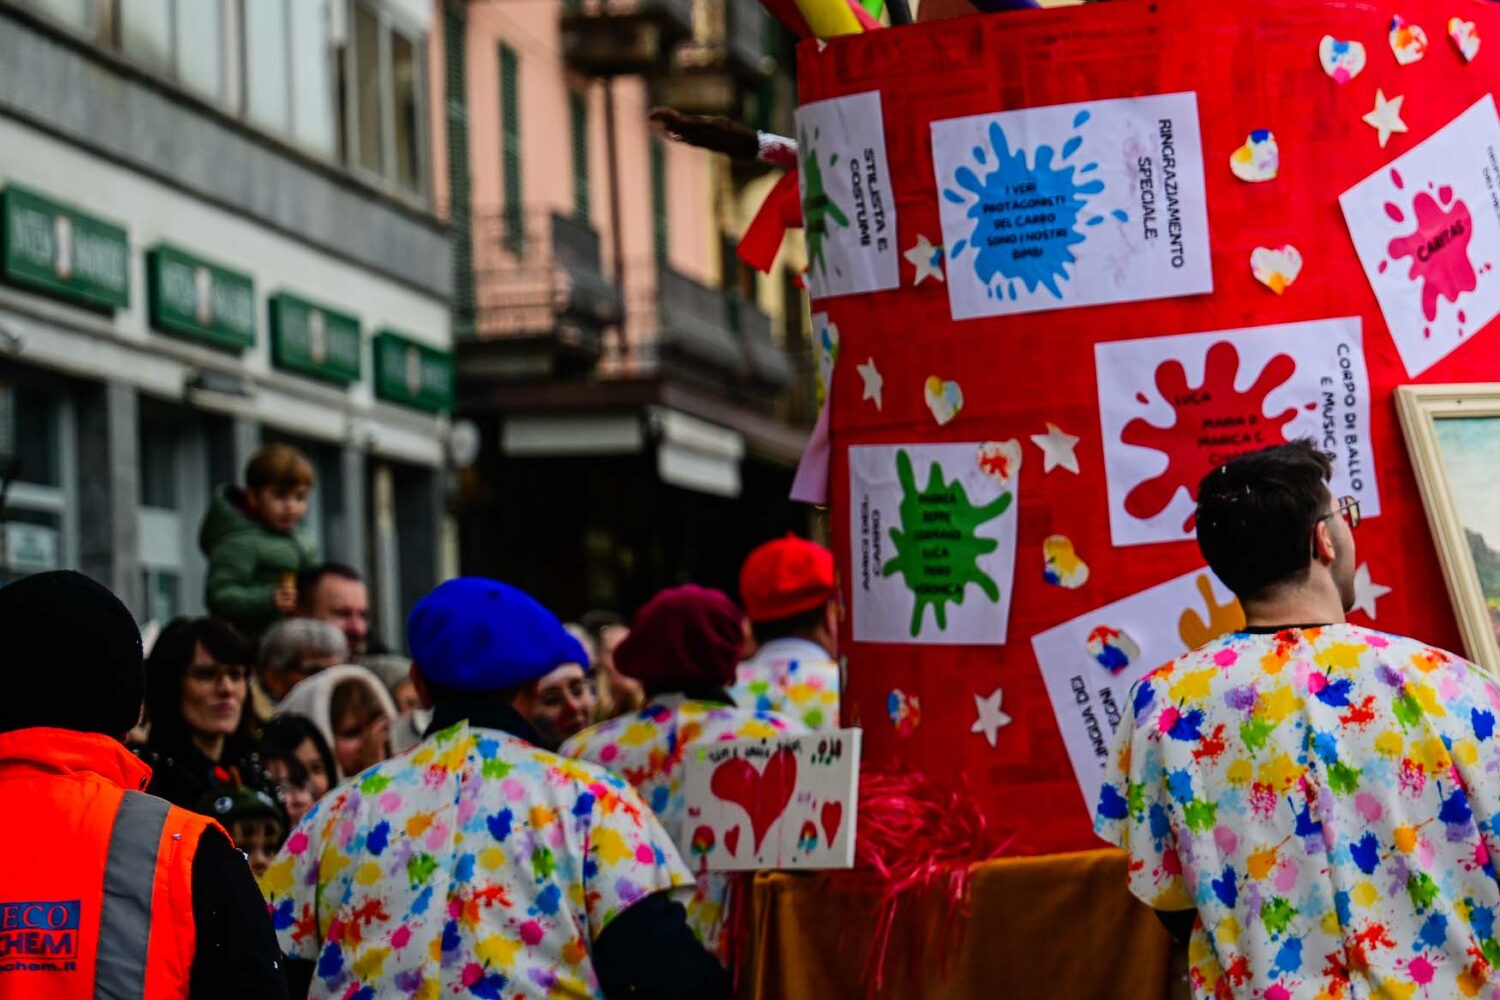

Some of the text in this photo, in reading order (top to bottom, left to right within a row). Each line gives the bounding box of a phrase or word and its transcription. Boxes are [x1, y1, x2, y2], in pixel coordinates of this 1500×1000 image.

[850, 158, 871, 246] COSTUMI
[863, 147, 888, 253] STILISTA E
[982, 195, 1066, 214] PROTAGONISTI
[1138, 156, 1158, 241] SPECIALE
[1158, 118, 1185, 269] RINGRAZIAMENTO
[987, 234, 1018, 248] SONO
[1026, 228, 1068, 241] NOSTRI
[1015, 213, 1057, 228] CARRO
[1417, 219, 1465, 263] CARITAS
[1174, 392, 1211, 406] LUCA
[1320, 376, 1337, 463] E MUSICA
[1337, 343, 1363, 491] CORPO DI BALLO
[872, 508, 882, 577] CARRO
[1070, 675, 1090, 704] DEI
[1099, 687, 1122, 735] EGNI
[3, 904, 69, 929] ECO
[0, 931, 72, 957] HEM
